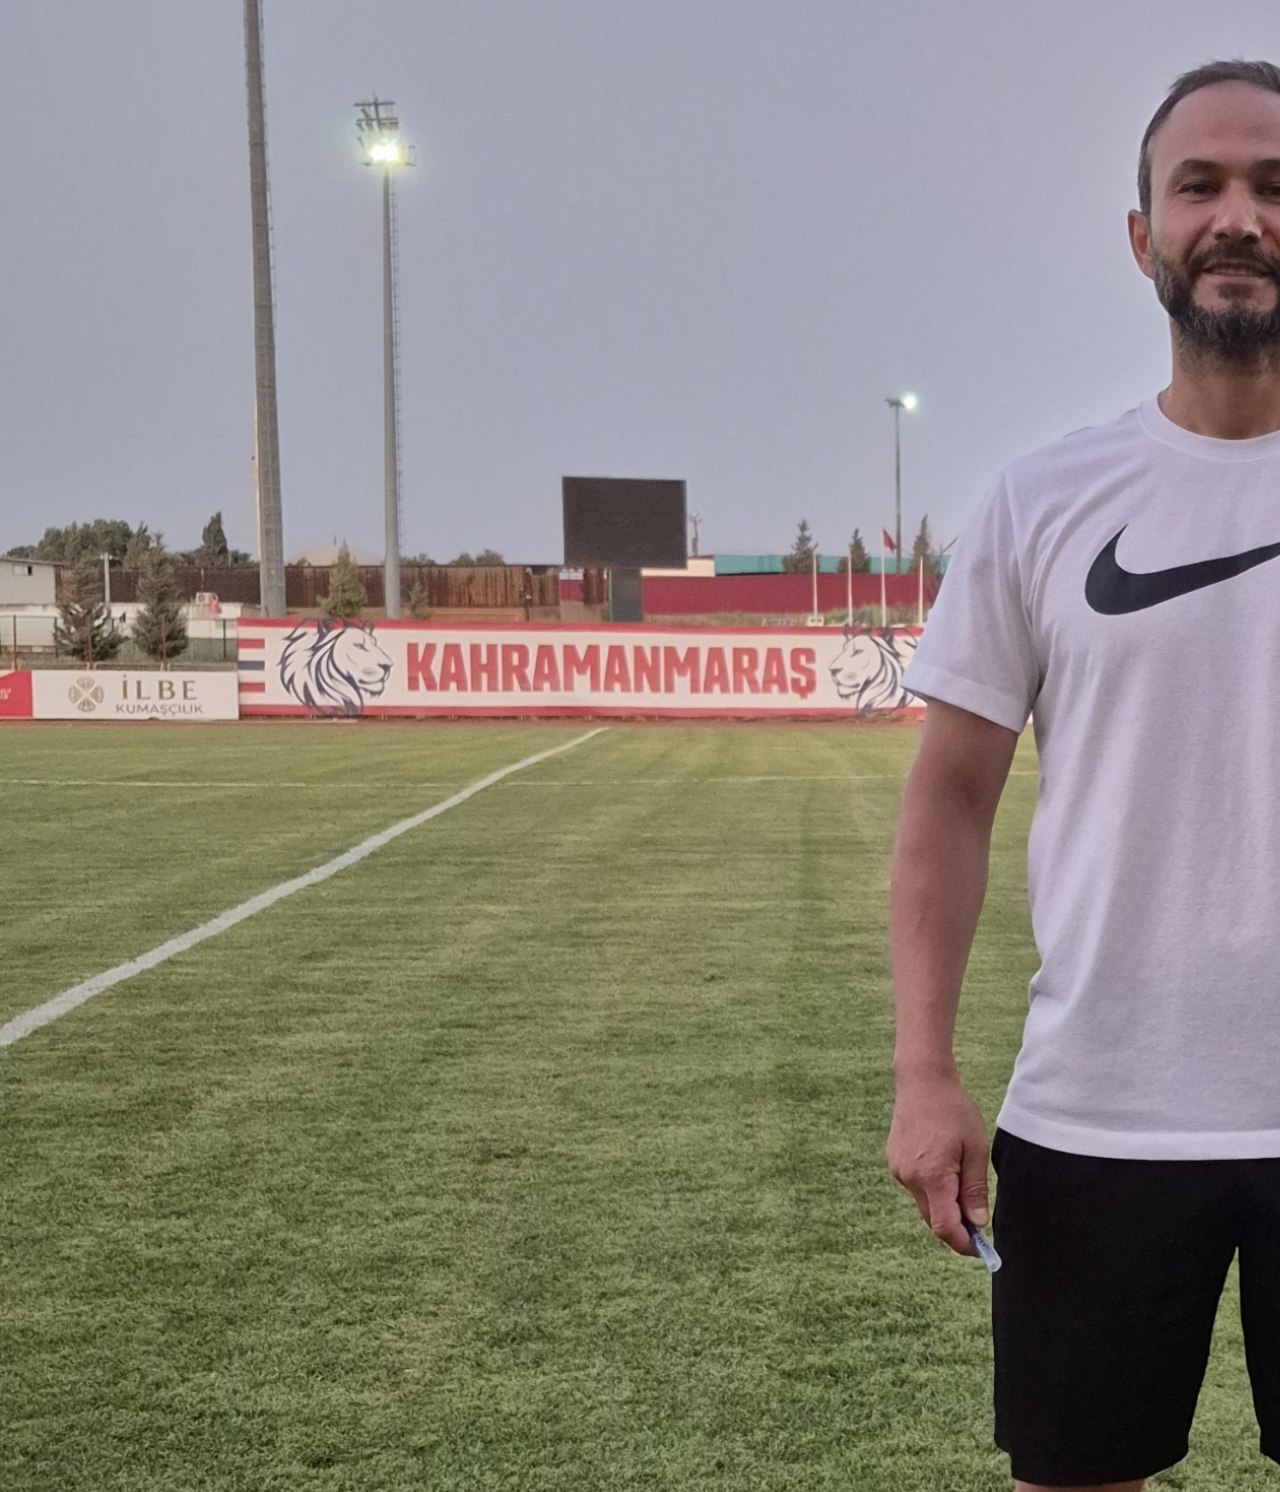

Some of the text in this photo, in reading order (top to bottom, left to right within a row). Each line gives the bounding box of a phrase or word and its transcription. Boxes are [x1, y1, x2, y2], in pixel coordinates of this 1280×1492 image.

[406, 642, 818, 700] KAHRAMANMARAŞ
[122, 674, 198, 700] İLBE
[115, 703, 204, 717] KUMAŞÇILIK
